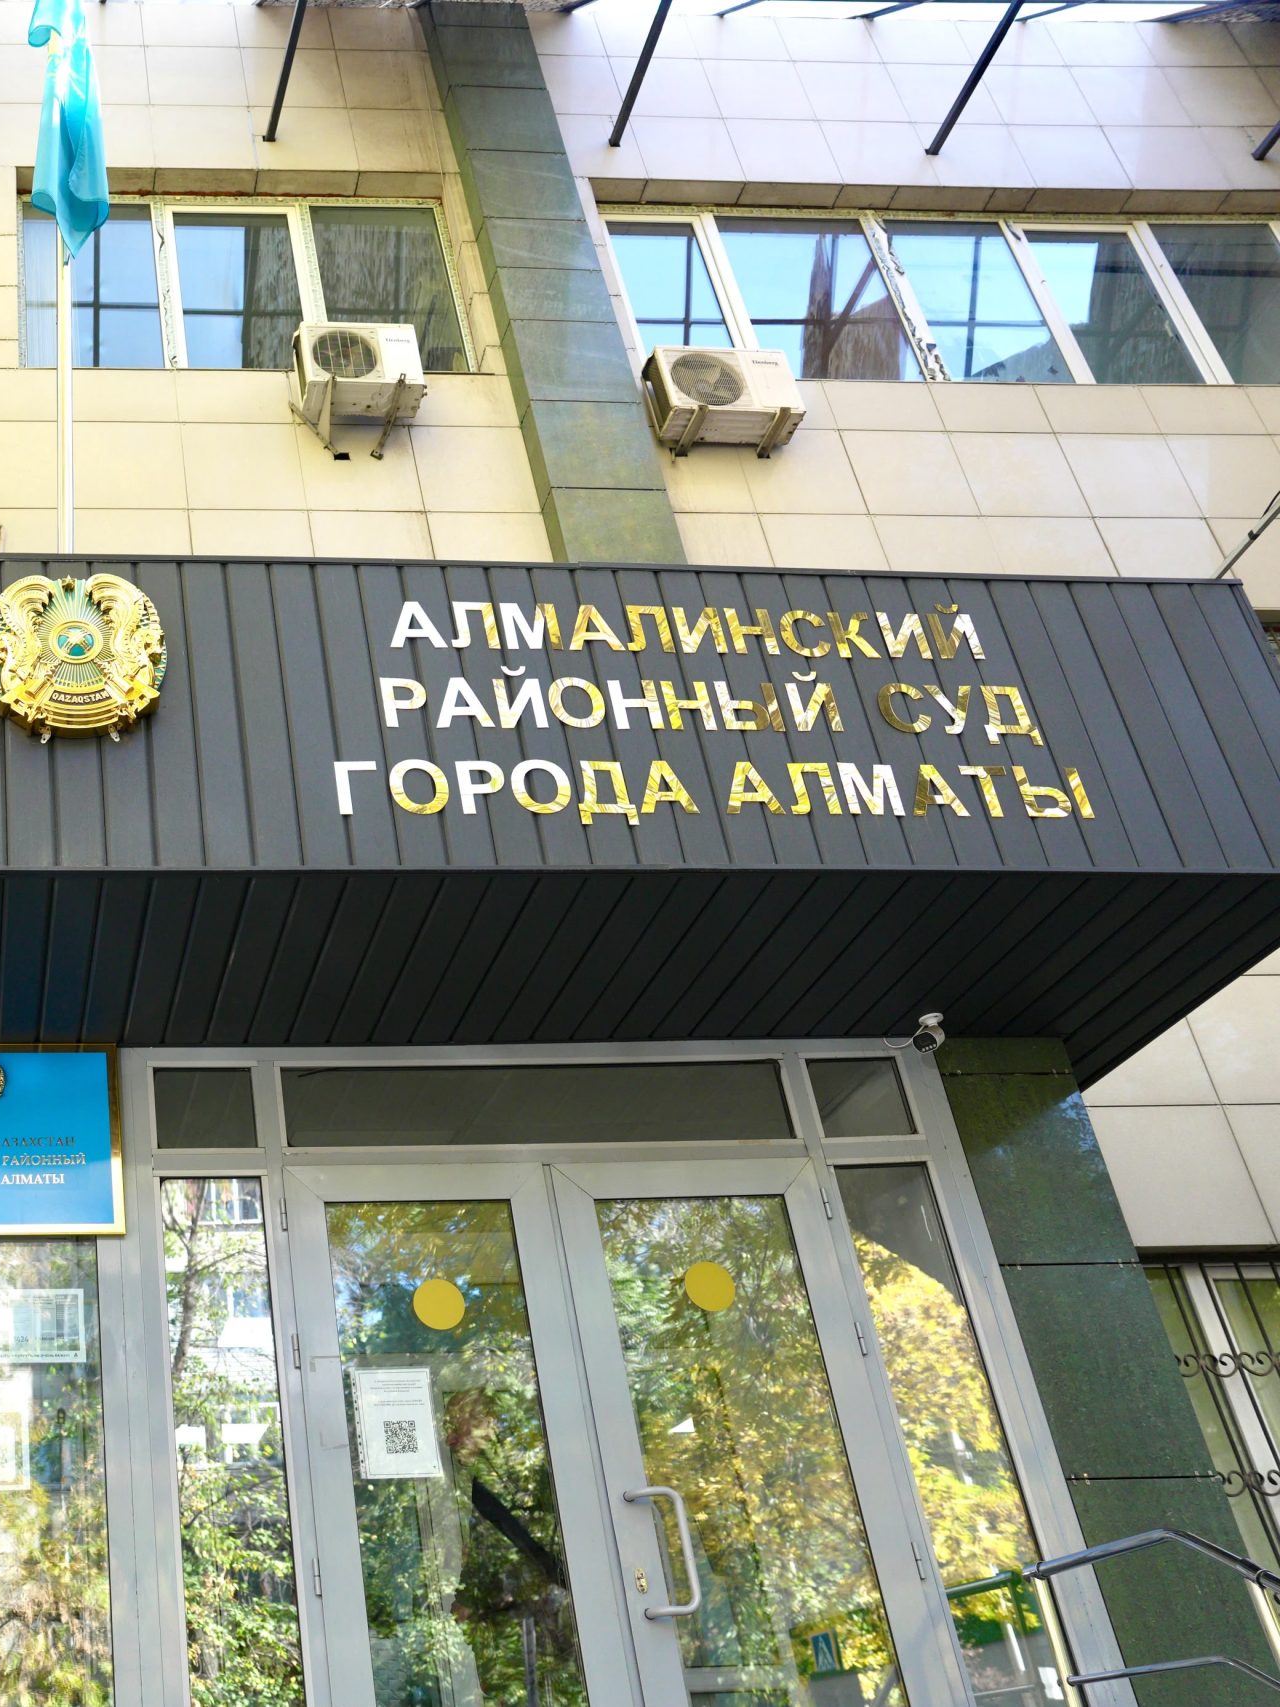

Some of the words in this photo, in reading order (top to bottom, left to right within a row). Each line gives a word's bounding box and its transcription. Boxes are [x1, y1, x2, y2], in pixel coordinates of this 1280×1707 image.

[389, 601, 986, 661] АЛМАЛИНСКИЙ
[51, 691, 109, 703] QAZAQSTAN
[378, 665, 845, 733] РАЙОННЫЙ
[877, 682, 1043, 746] СУД
[332, 758, 701, 826] ГОРОДА
[726, 761, 1096, 820] АЛМАТЫ
[2, 1152, 86, 1166] РАЙОННЫЙ
[0, 1173, 65, 1185] АЛМАТЫ
